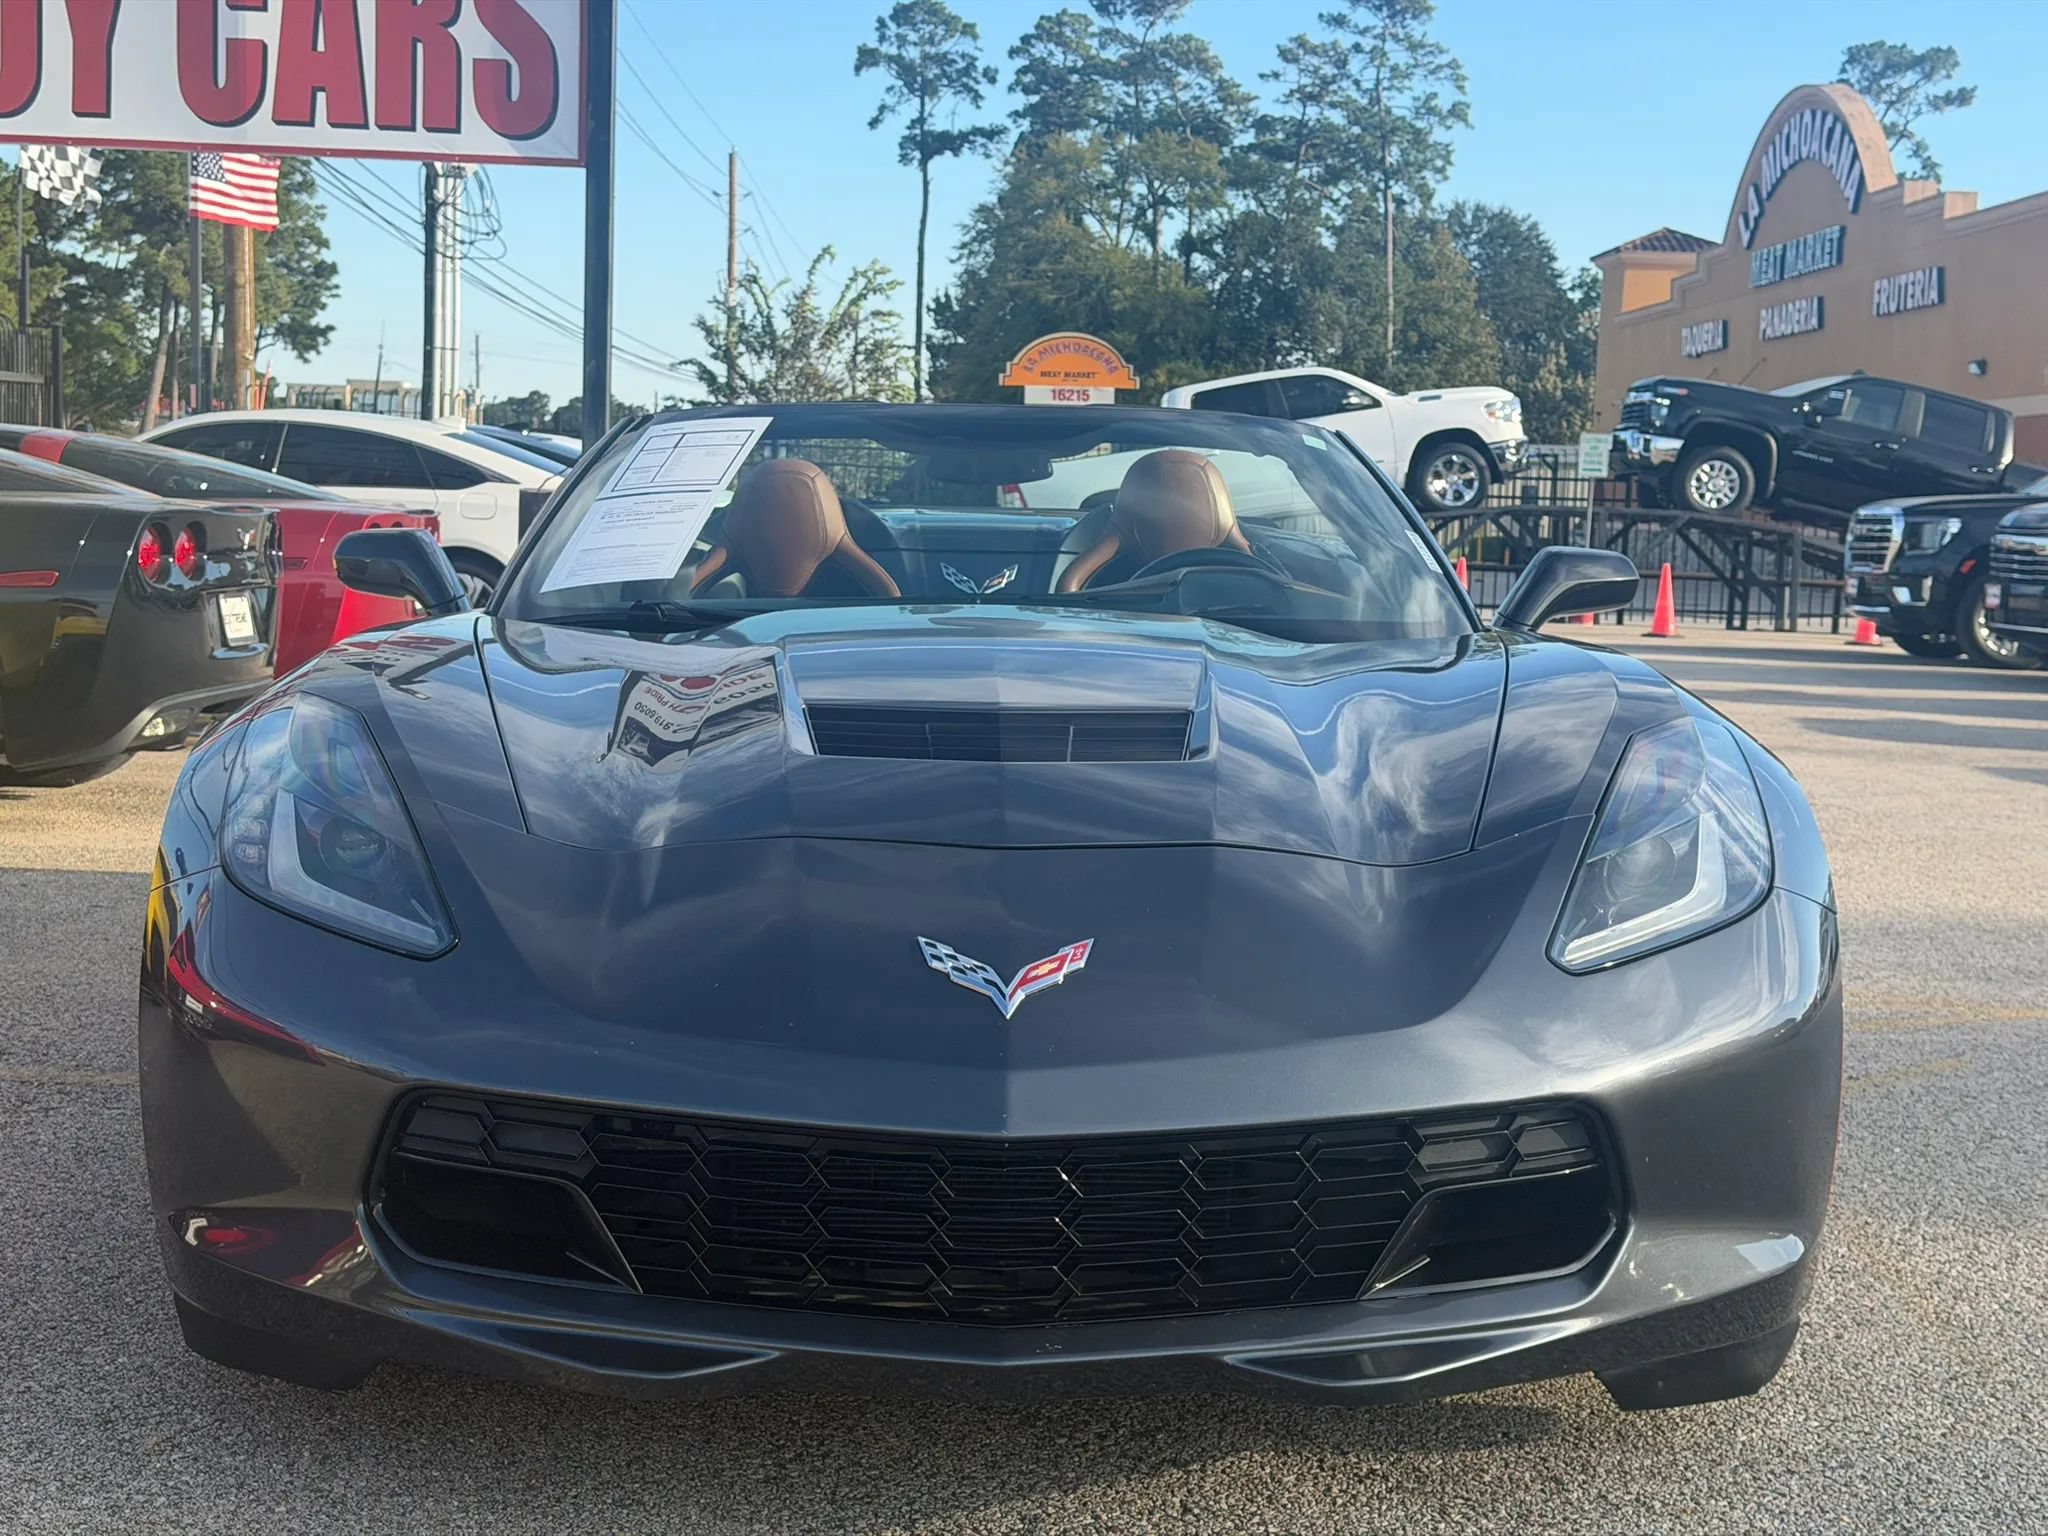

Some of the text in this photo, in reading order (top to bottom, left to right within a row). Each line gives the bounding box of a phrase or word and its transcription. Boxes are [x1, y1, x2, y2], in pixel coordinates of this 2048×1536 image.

[176, 0, 559, 140] CARS
[1738, 108, 1863, 250] LA MICHOACANA
[1750, 224, 1846, 289] MEAT MARKET
[1872, 266, 1944, 318] FRUTERIA
[1681, 319, 1727, 359] TAQUERIA
[1758, 296, 1823, 342] PANADERIA
[1040, 370, 1097, 379] MEAT MARKET
[1051, 388, 1090, 402] 16215
